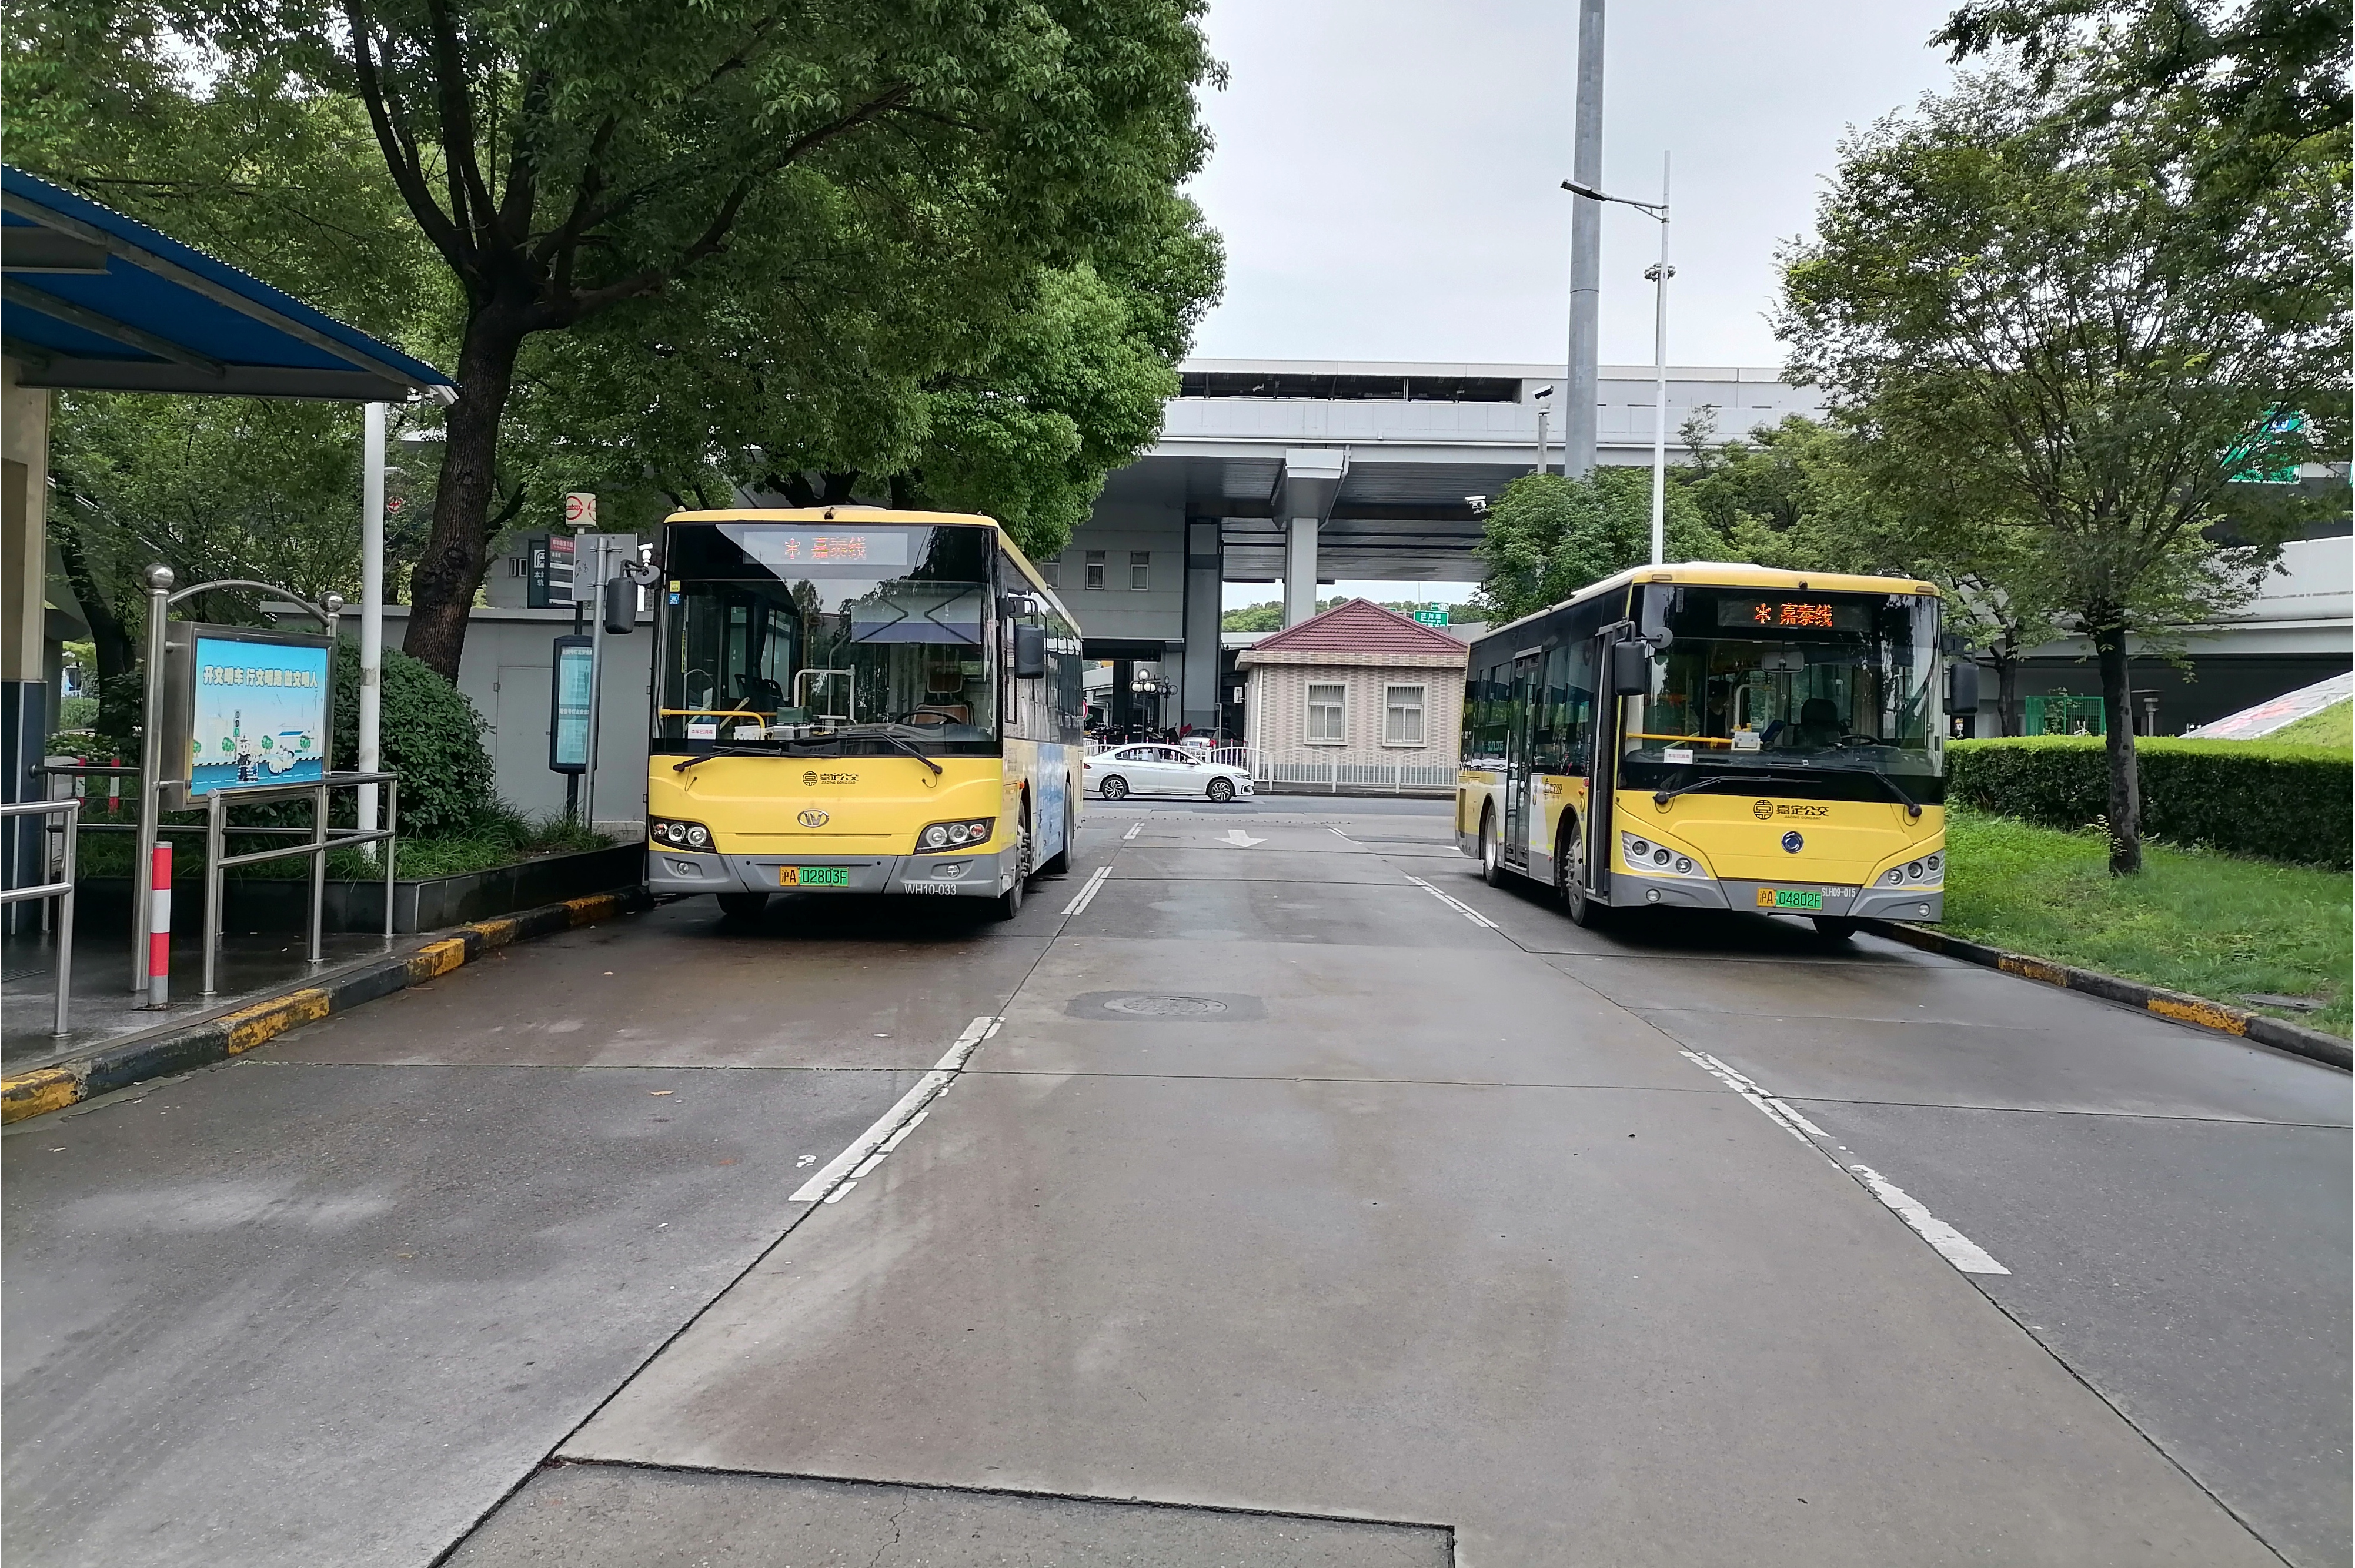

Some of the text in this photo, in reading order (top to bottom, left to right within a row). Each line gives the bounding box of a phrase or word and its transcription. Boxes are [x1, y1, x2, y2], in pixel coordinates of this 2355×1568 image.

[810, 536, 867, 560] 嘉泰线
[1779, 603, 1833, 627] 嘉泰线
[203, 665, 318, 688] 开文明车 行文明路 做文明人
[820, 773, 859, 781] 嘉定公交
[1776, 804, 1829, 817] 嘉定公交
[904, 884, 957, 895] WH10-033
[1822, 887, 1856, 898] SLH09-015
